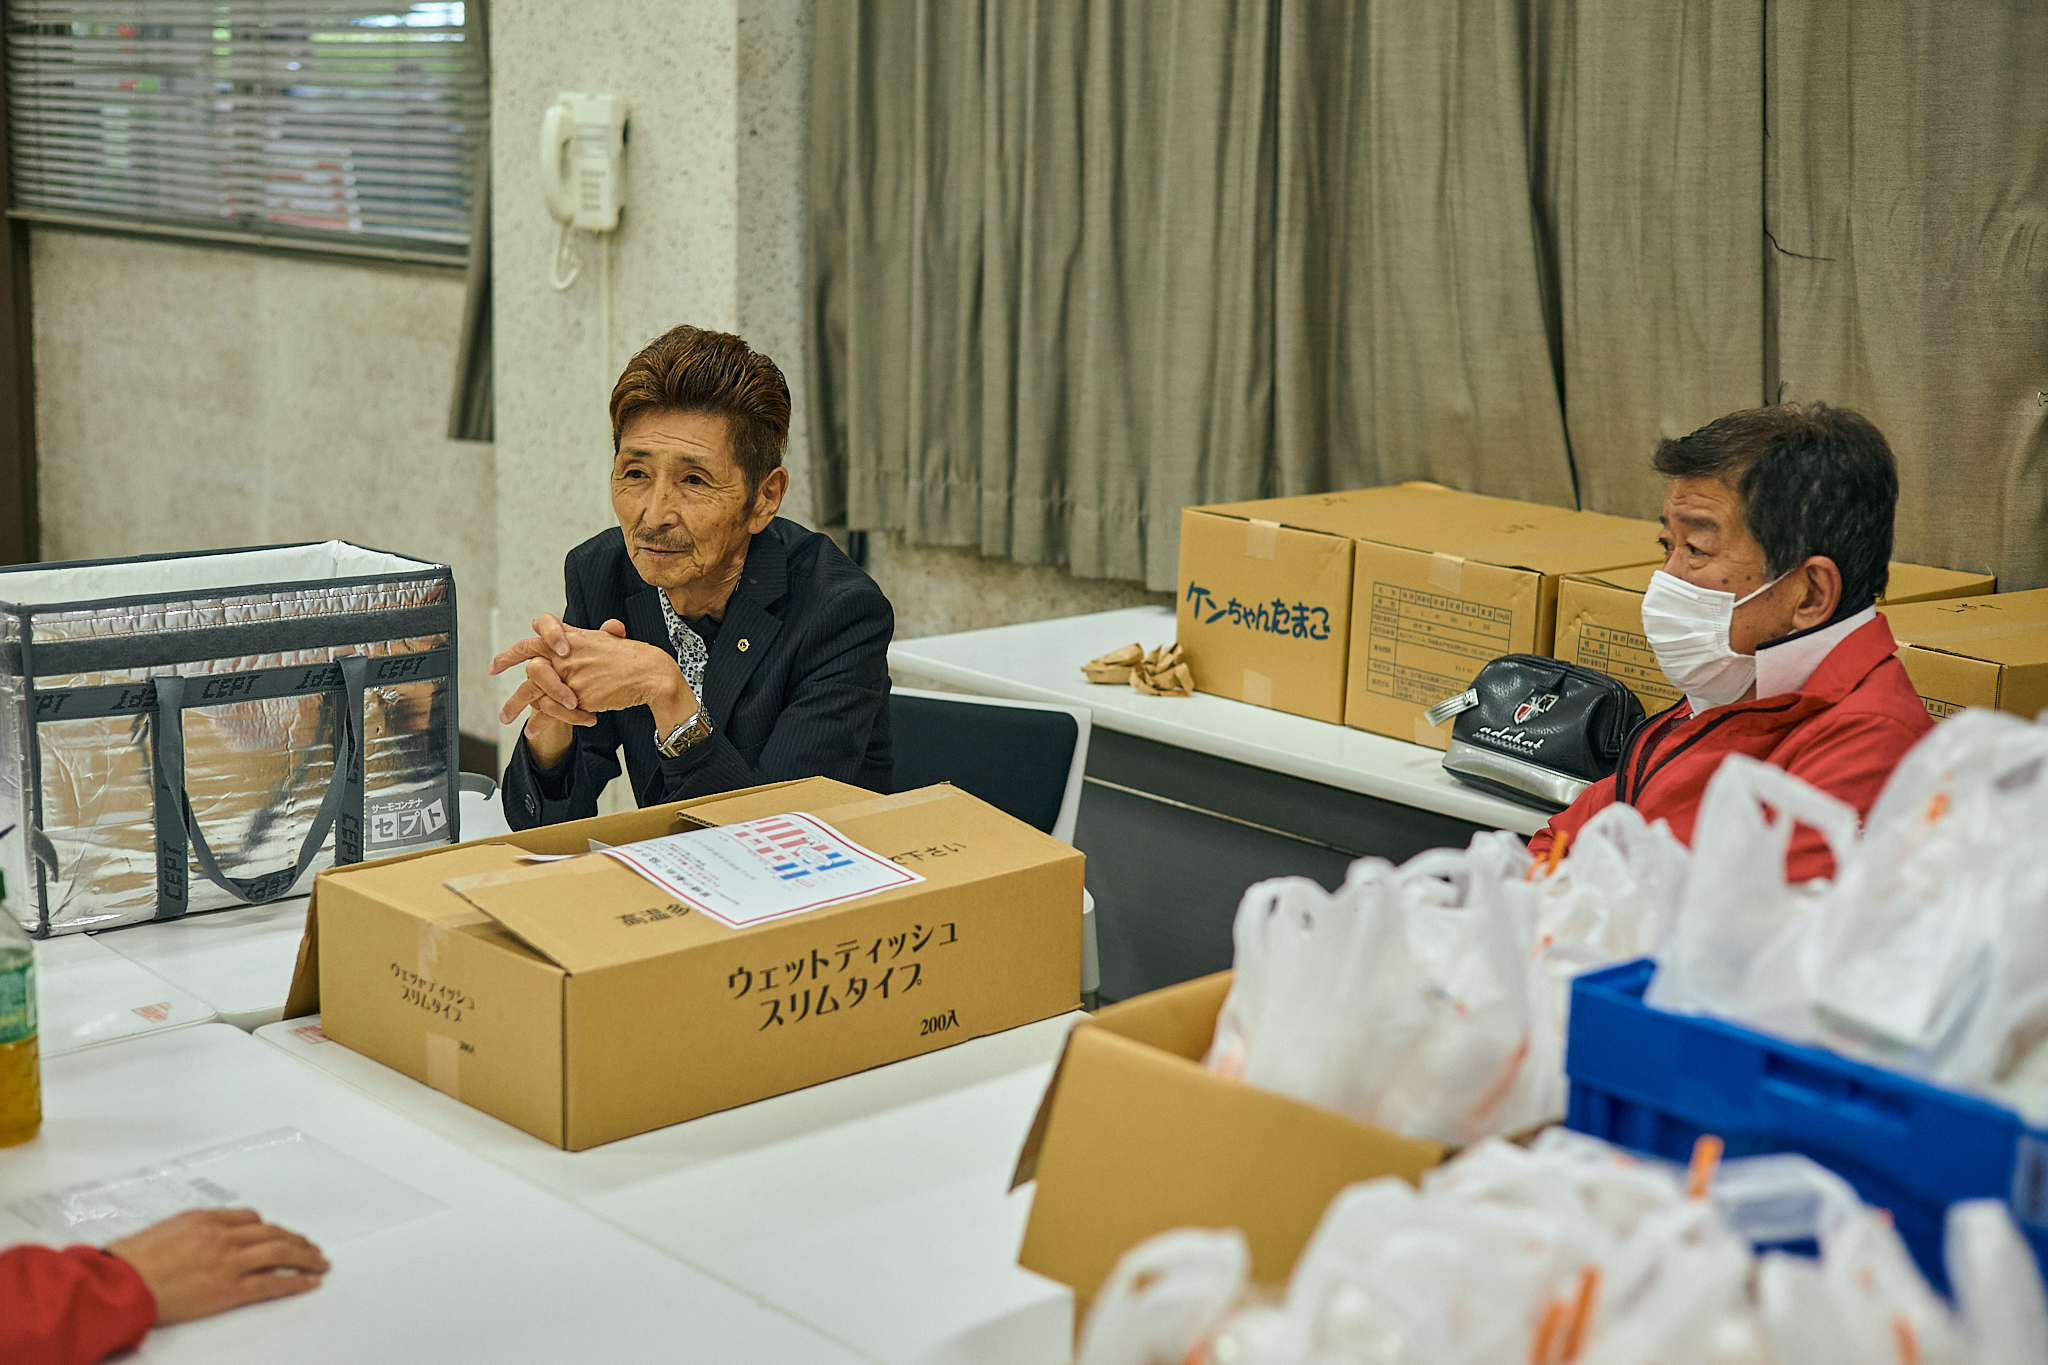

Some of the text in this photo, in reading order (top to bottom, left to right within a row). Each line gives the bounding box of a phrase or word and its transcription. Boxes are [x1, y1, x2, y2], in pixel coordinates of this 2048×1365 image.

[1187, 581, 1330, 640] ケンちゃんたまご
[376, 656, 427, 680] CEPT
[201, 674, 261, 699] CEPT
[371, 797, 423, 814] サーモコンテナ
[374, 807, 442, 839] セプト
[163, 841, 182, 901] CEPT
[728, 922, 959, 999] ウェットティッシュ
[758, 962, 923, 1032] スリムタイプ
[920, 1009, 960, 1037] 200入
